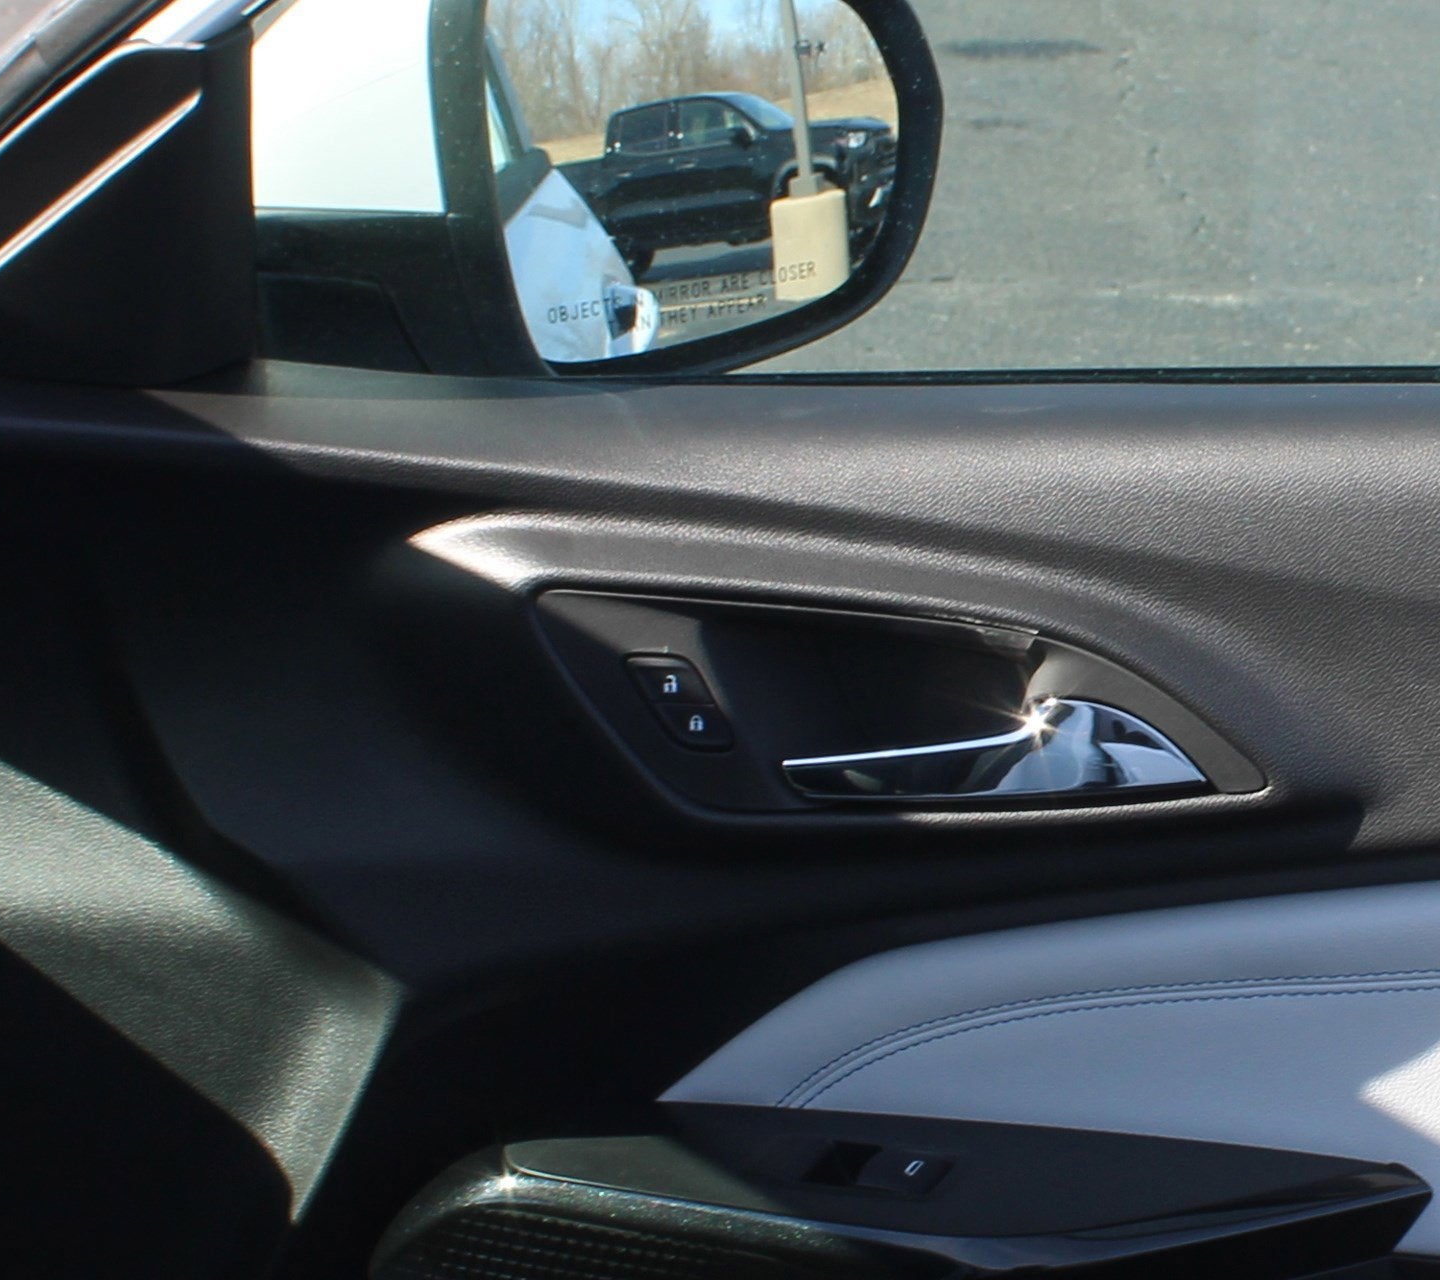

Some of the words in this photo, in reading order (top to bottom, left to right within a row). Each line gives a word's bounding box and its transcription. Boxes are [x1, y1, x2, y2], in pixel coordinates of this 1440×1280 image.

[721, 273, 749, 293] ARE
[759, 261, 817, 286] CLOSER
[660, 307, 697, 328] THEY
[707, 293, 767, 318] APPEAR
